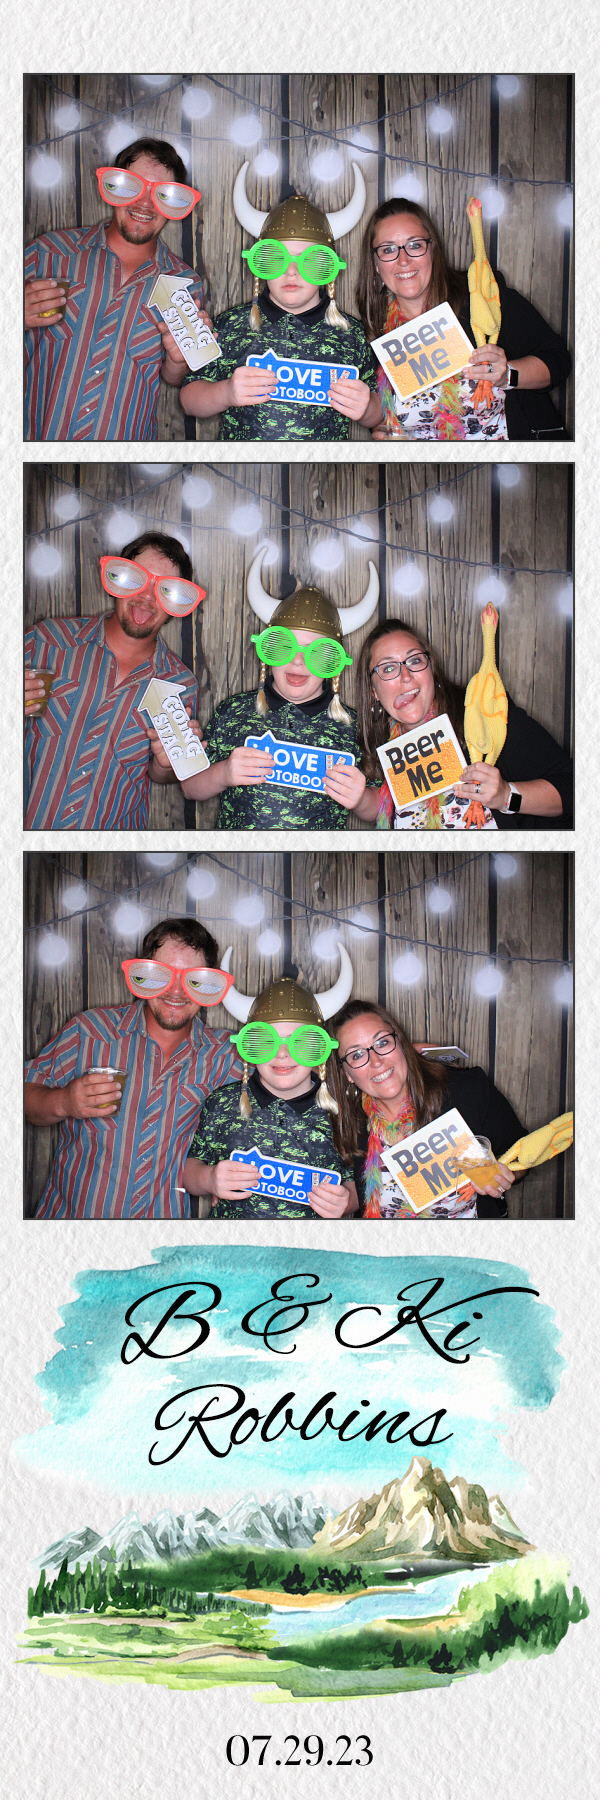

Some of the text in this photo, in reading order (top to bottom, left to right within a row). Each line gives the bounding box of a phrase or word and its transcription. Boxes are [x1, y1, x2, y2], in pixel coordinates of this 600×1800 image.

[163, 306, 196, 352] STAG
[170, 289, 214, 349] GOING
[381, 317, 448, 367] Beer
[408, 348, 451, 386] Me
[152, 713, 184, 760] STAG
[161, 695, 203, 759] GOING
[385, 730, 445, 775] Beer
[406, 761, 444, 798] Me
[391, 1124, 458, 1178] Beer
[420, 1157, 463, 1197] Me
